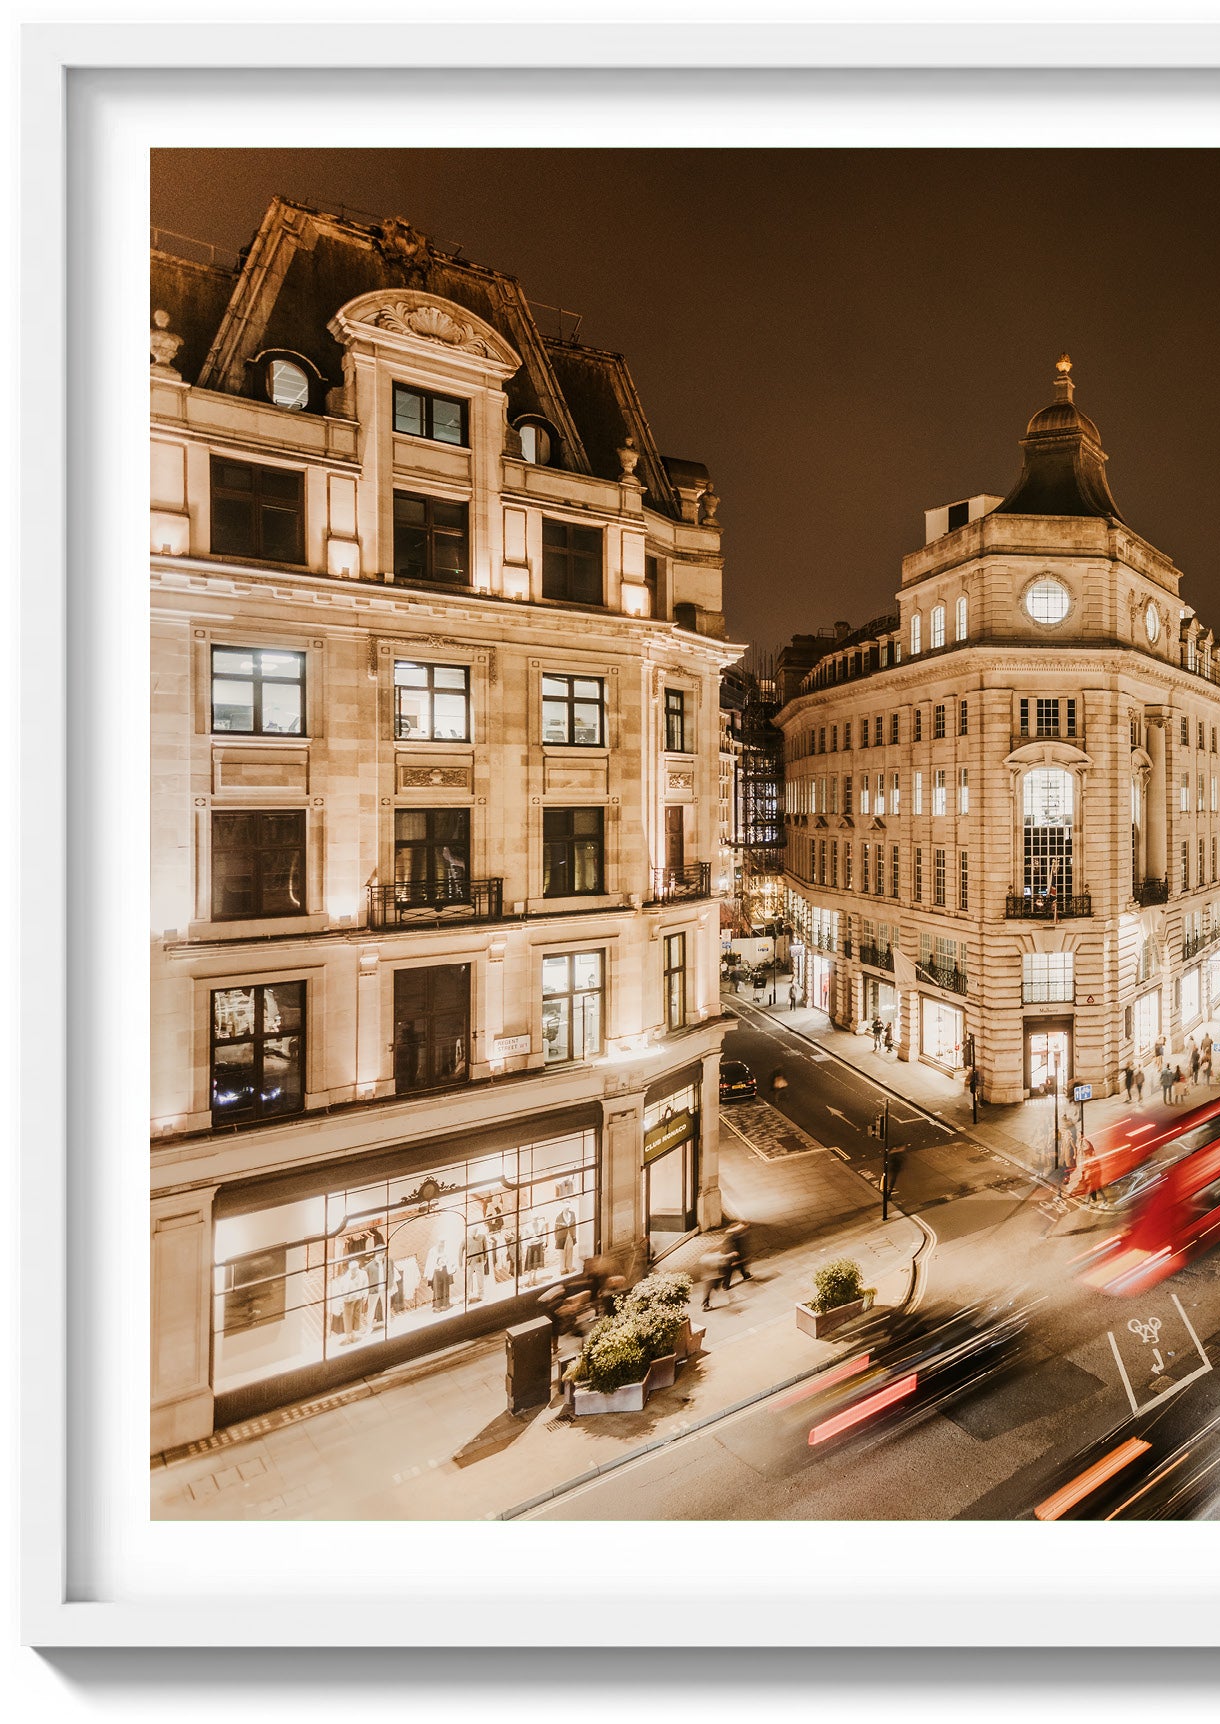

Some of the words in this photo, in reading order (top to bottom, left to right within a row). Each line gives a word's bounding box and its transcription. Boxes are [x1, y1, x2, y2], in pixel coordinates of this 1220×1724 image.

[497, 1038, 519, 1047] REGENT
[645, 1138, 662, 1152] CLUB
[662, 1123, 687, 1142] MONACO
